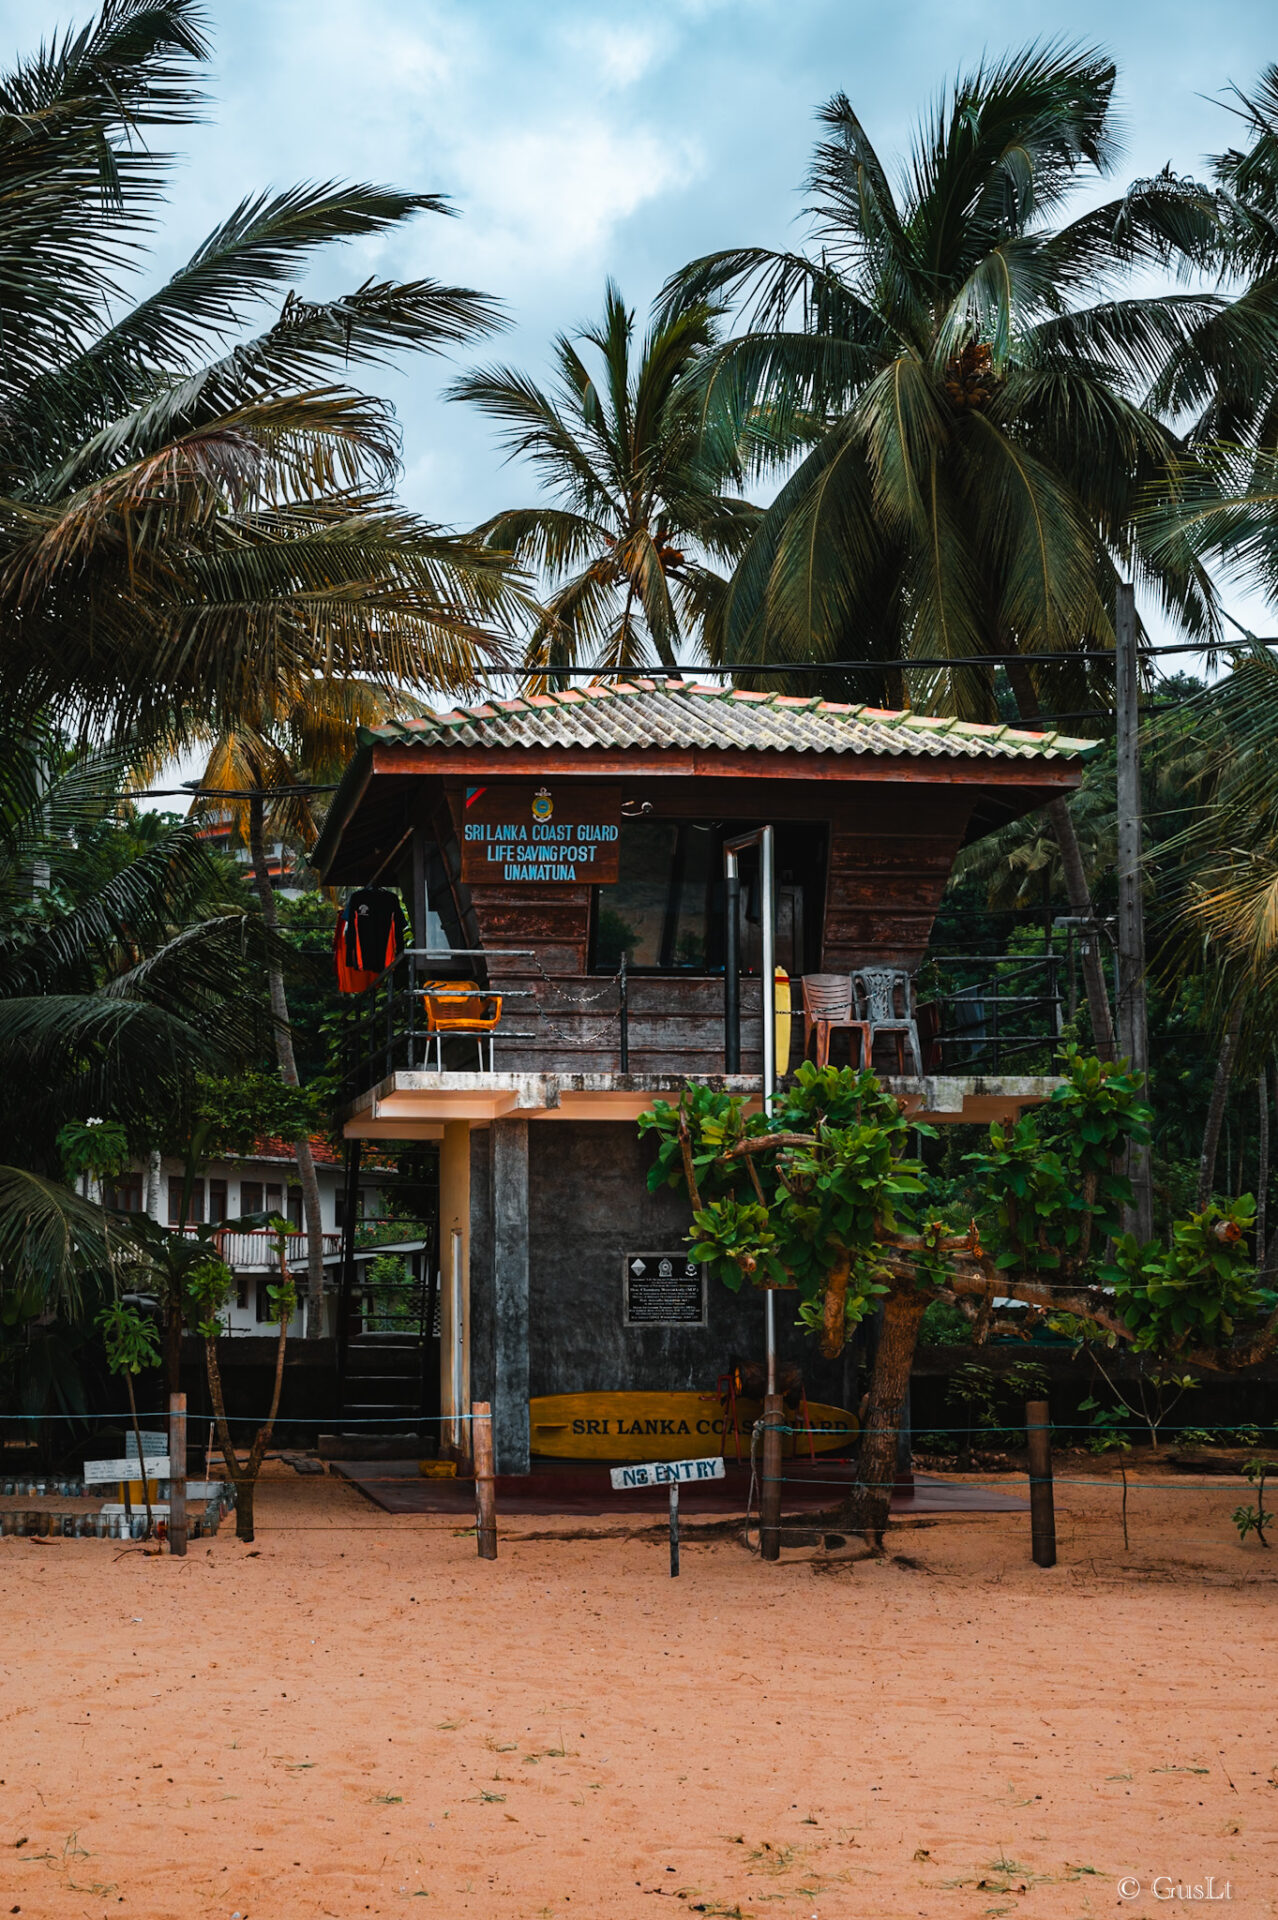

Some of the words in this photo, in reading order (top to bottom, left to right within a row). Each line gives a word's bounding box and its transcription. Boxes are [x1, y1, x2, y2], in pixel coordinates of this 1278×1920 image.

[464, 824, 484, 841] SRI
[486, 824, 527, 841] LANKA
[532, 824, 573, 841] COAST
[577, 824, 619, 841] GUARD
[487, 845, 515, 862] LIFE
[516, 845, 558, 862] SAVING
[559, 845, 597, 862] POST
[504, 864, 576, 881] UNAWATUNA
[572, 1419, 610, 1435] SRI
[617, 1419, 690, 1435] LANKA
[696, 1419, 757, 1435] COAS
[784, 1419, 849, 1435] UARD
[623, 1468, 649, 1487] NO
[655, 1460, 717, 1482] ENTRY
